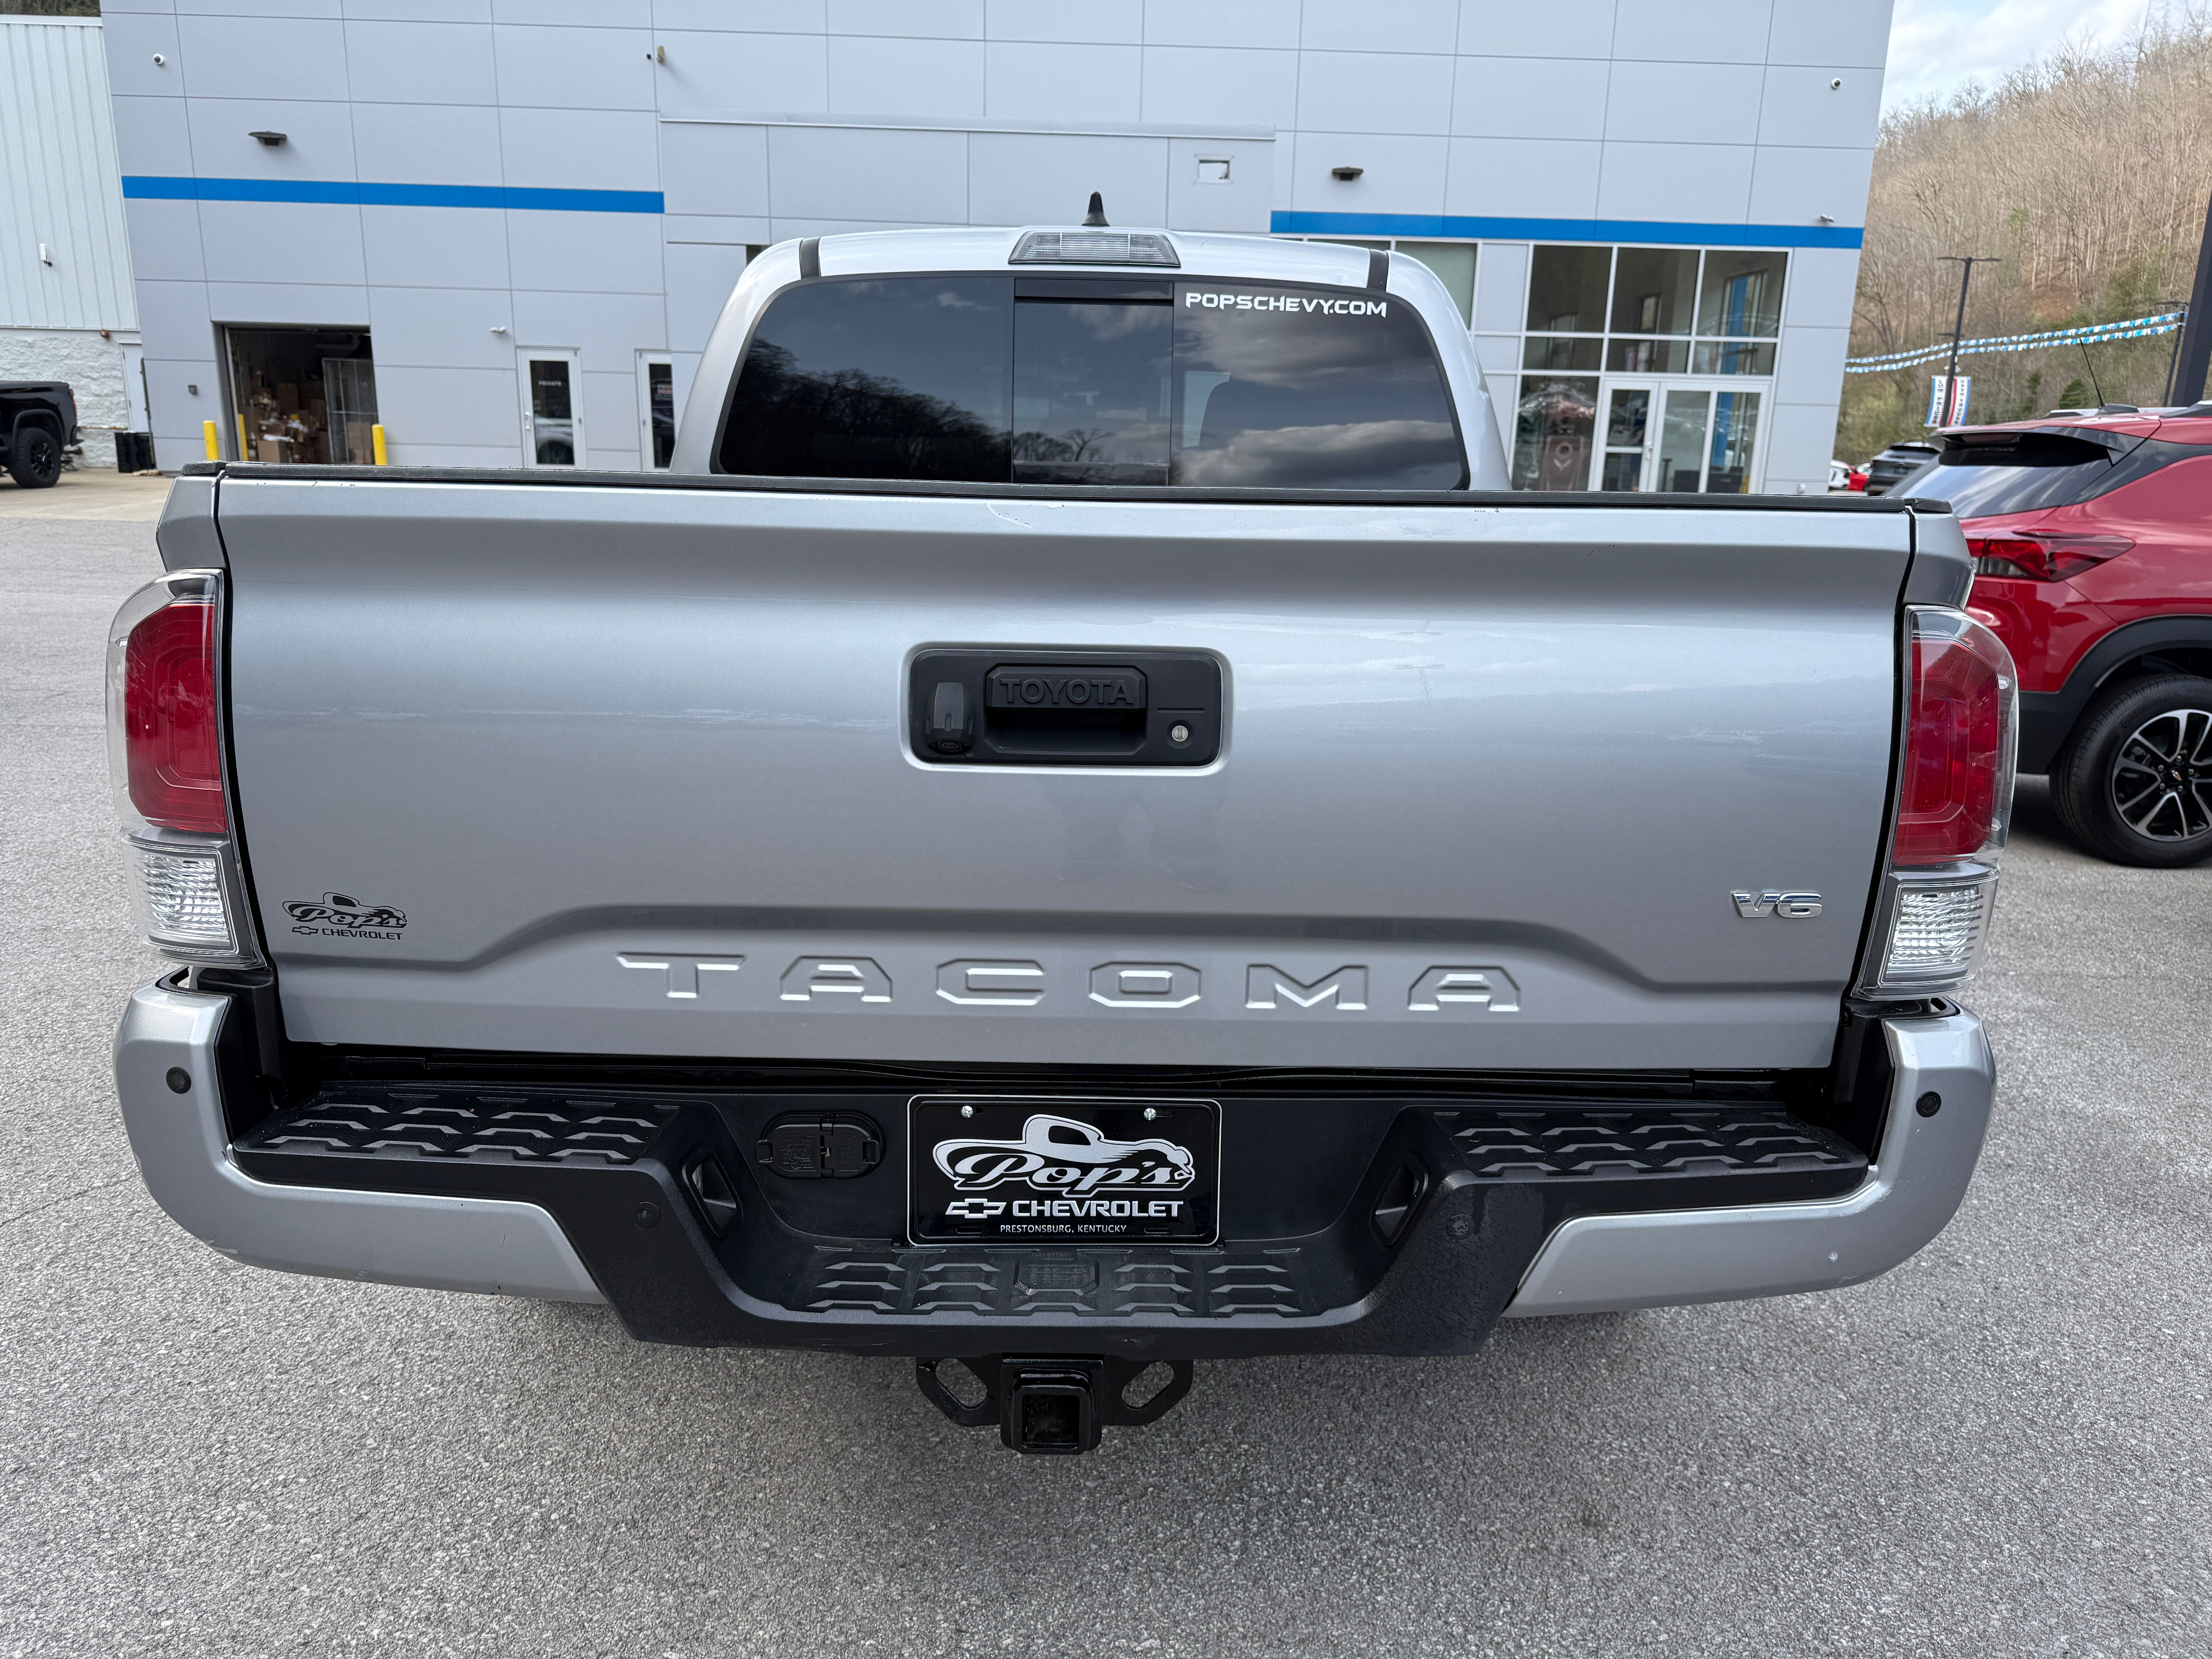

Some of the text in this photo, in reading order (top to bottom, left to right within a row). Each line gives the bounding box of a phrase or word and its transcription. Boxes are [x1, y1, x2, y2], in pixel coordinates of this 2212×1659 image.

[1185, 292, 1387, 318] POPSCHEVY.COM
[999, 678, 1135, 706] TOYOTA
[1731, 892, 1823, 918] V6
[321, 928, 403, 940] CHEVROLET
[616, 951, 1520, 1012] TACOMA
[954, 1153, 1180, 1190] Pop's
[1012, 1200, 1184, 1218] CHEVROLET
[1000, 1224, 1127, 1233] PRESTONSBURG, KENTUCKY
